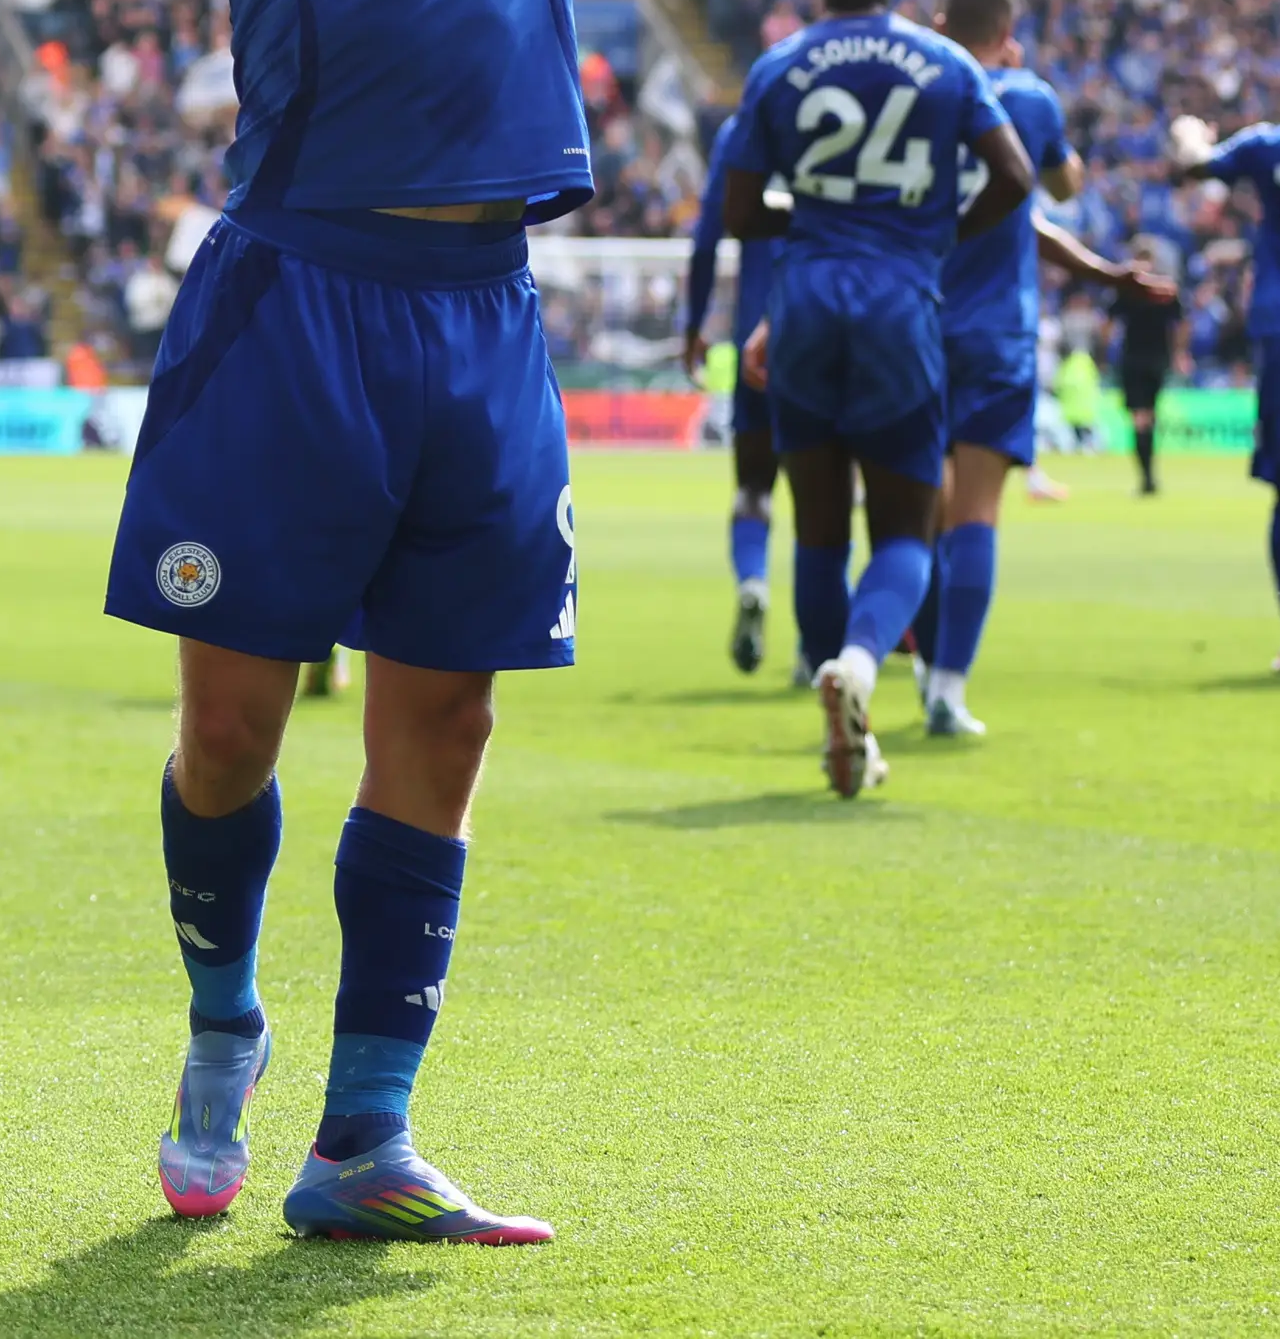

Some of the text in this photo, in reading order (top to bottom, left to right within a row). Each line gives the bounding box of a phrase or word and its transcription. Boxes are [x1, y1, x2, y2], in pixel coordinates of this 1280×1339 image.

[791, 85, 936, 207] 24
[165, 547, 215, 580] LEICESTER CITY
[161, 569, 212, 601] FOOTBALL CLUB
